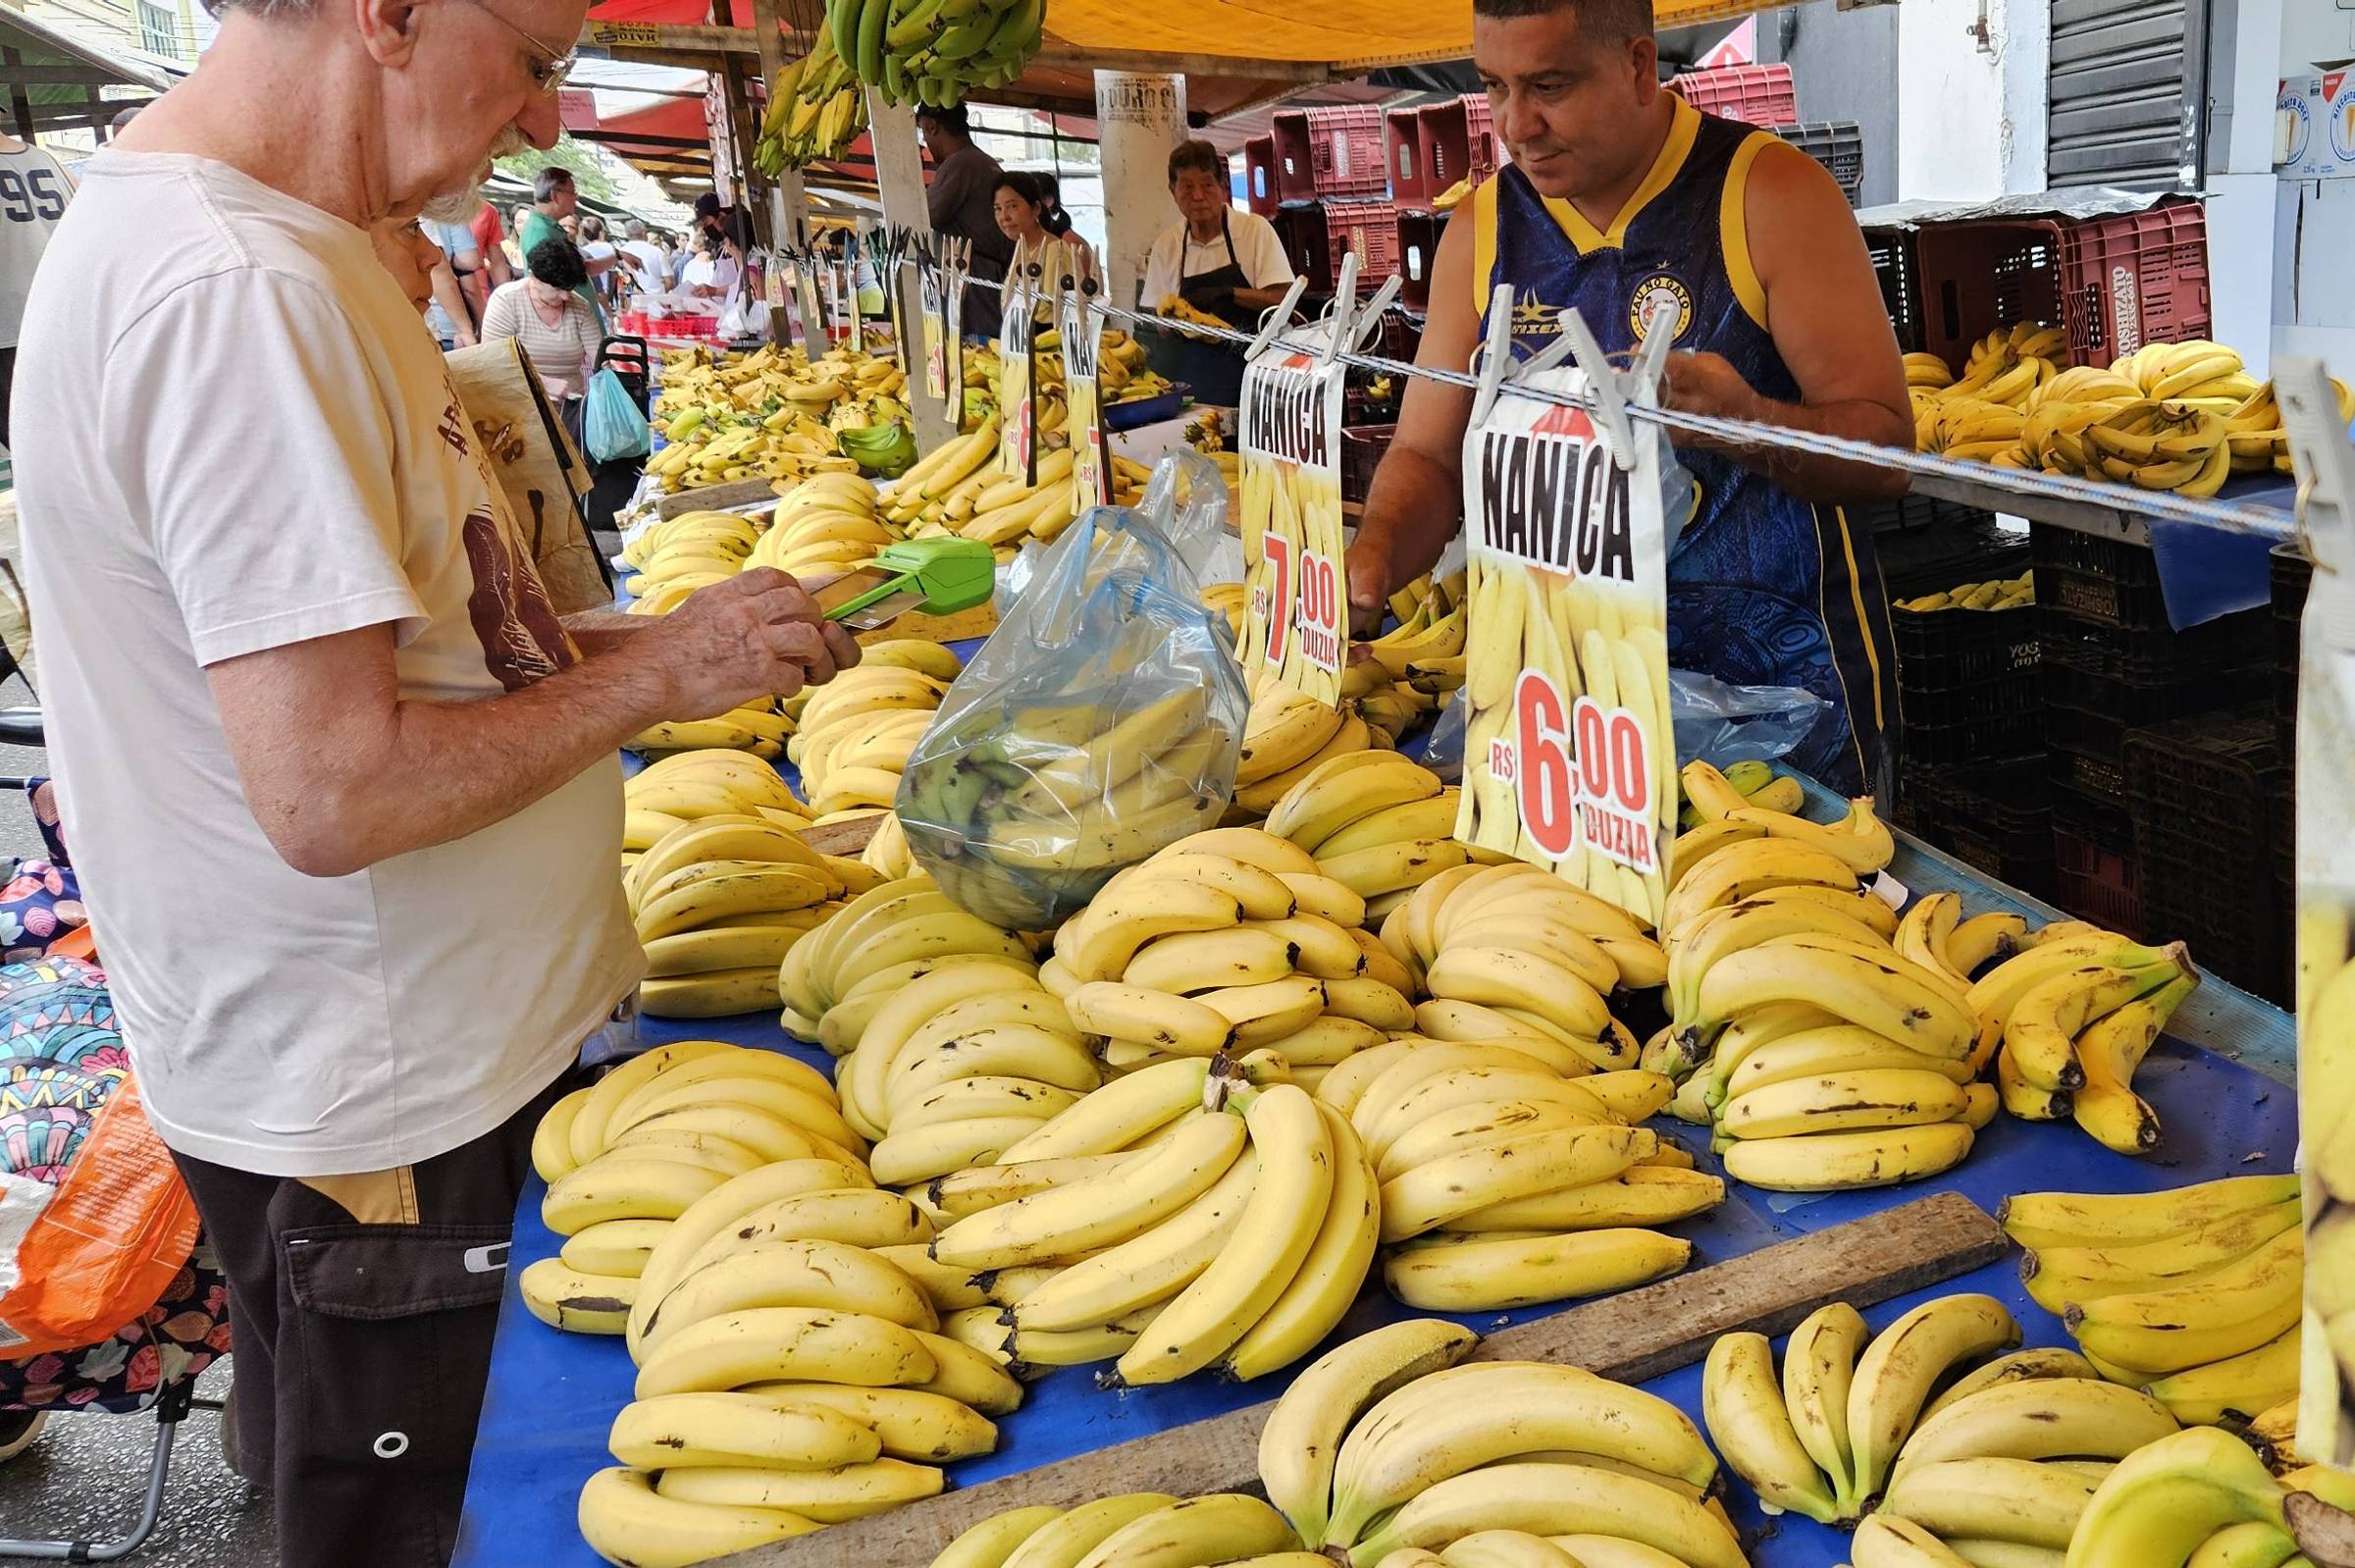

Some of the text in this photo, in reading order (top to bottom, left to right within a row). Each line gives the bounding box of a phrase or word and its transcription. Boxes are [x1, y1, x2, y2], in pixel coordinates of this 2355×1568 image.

[0, 169, 65, 222] 95
[1632, 278, 1690, 316] PAU NO GATO
[1249, 368, 1329, 468] NANICA
[1483, 432, 1635, 583] NANICA
[1303, 627, 1335, 668] DUZIA
[1492, 675, 1647, 854] R$ 6,00
[1583, 801, 1651, 866] DUZIA
